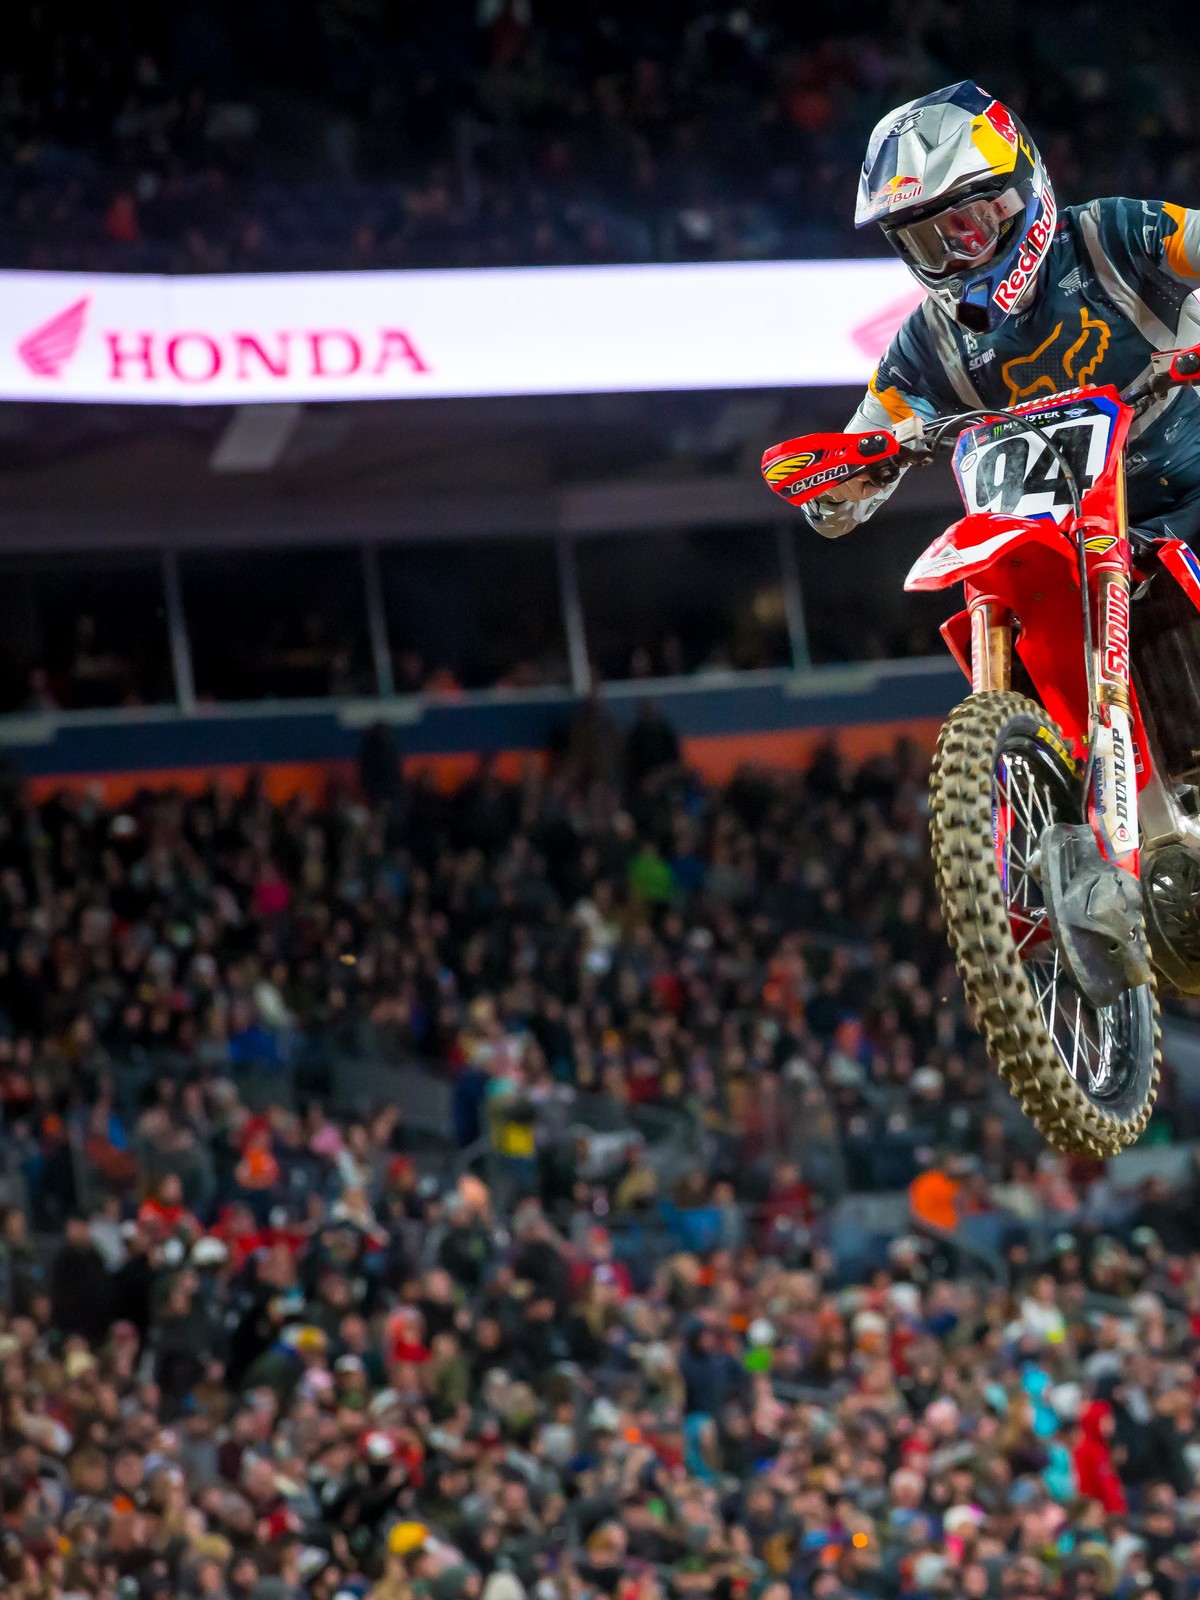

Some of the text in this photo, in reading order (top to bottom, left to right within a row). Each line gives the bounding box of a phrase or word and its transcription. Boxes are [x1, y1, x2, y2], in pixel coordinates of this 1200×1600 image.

[892, 186, 922, 203] Bull
[994, 187, 1055, 312] Red Bull
[105, 327, 431, 381] HONDA
[1000, 386, 1084, 412] ENTHAL
[791, 464, 849, 494] CYCRA
[976, 425, 1094, 513] 94
[1106, 582, 1129, 685] SHOWA
[1112, 728, 1128, 822] DUNLOP
